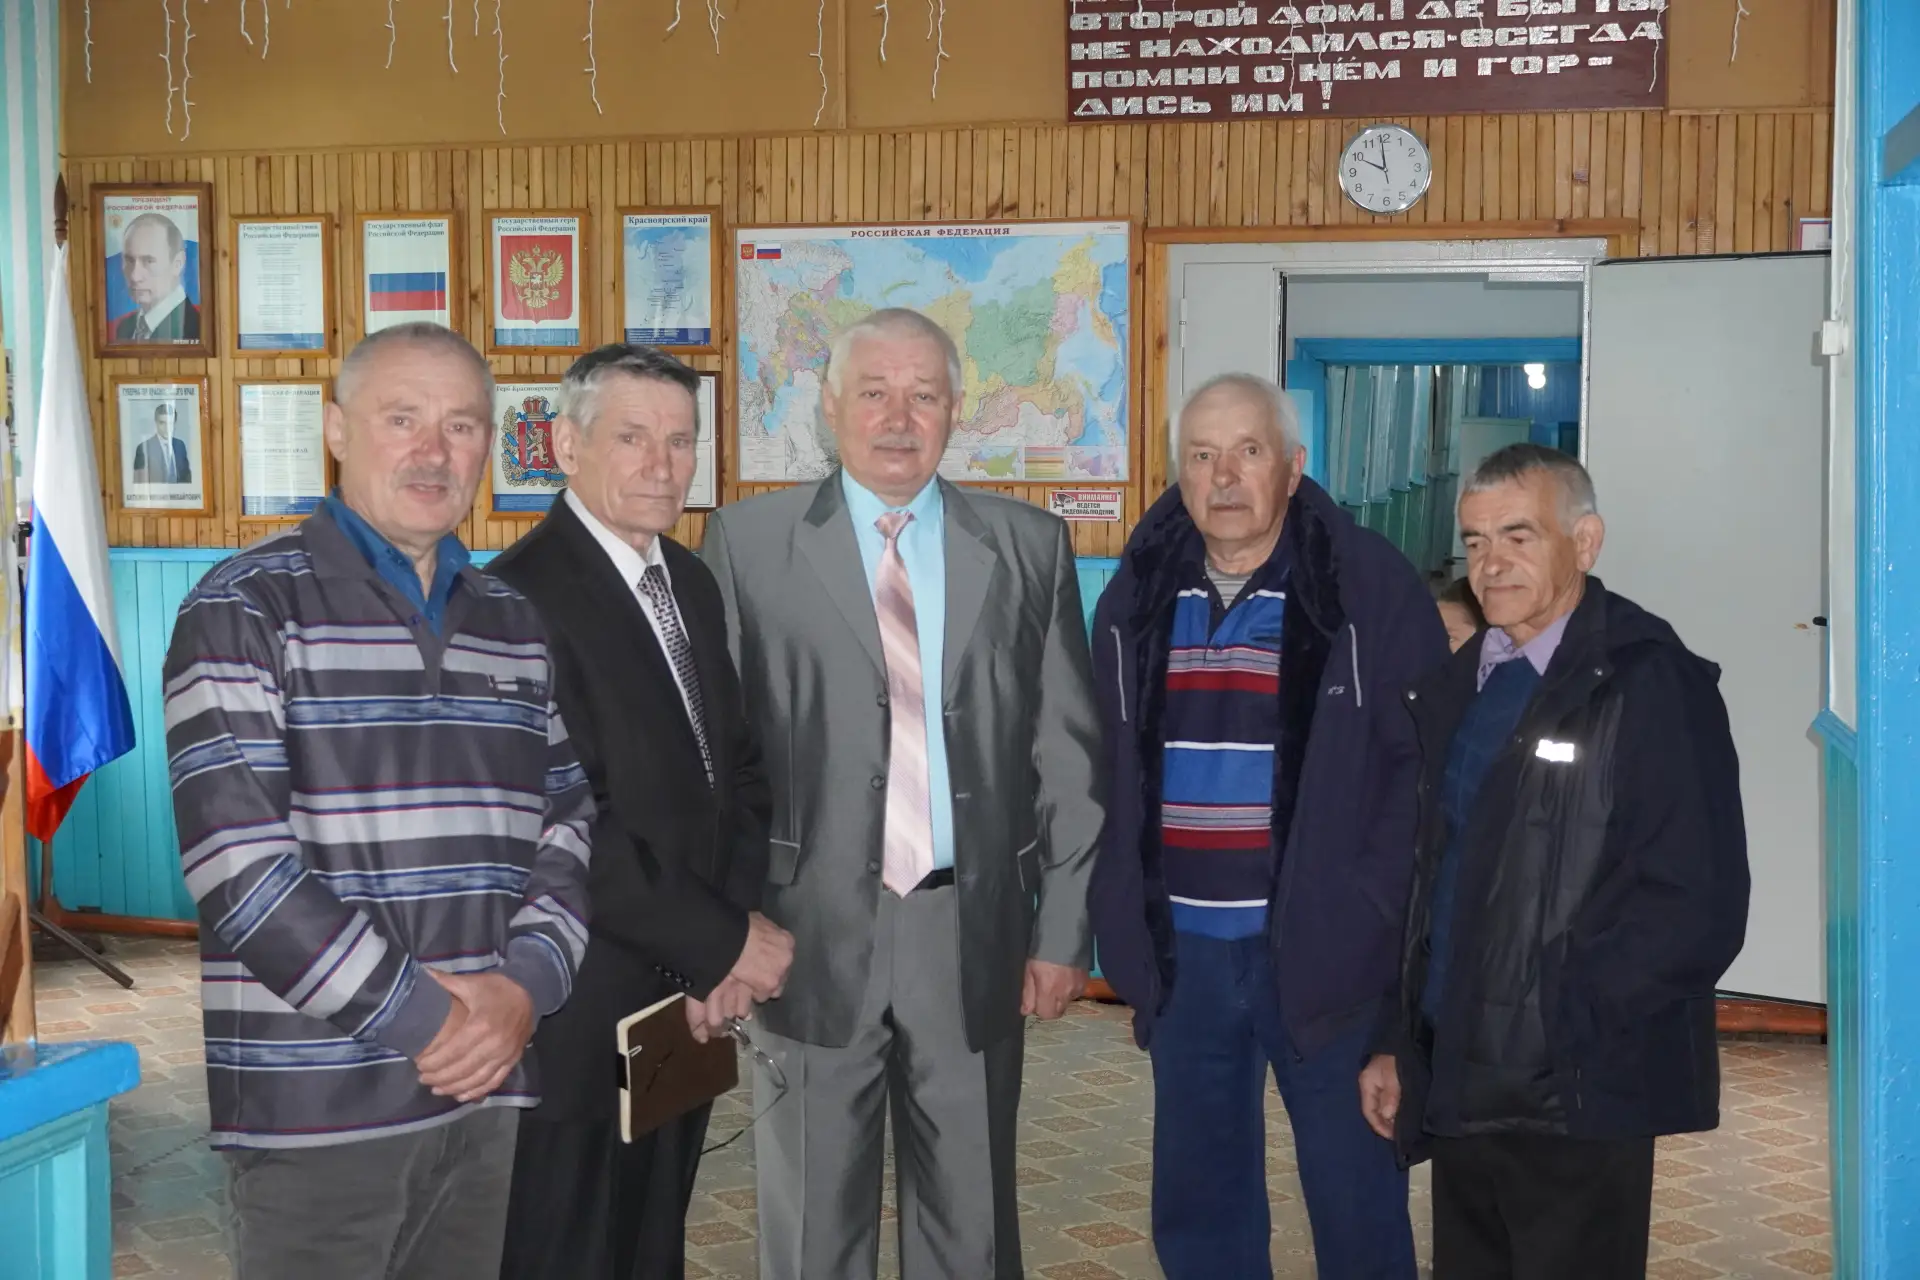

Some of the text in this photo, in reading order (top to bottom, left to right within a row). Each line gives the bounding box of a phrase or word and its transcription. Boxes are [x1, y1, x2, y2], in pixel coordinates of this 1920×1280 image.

[1069, 1, 1258, 31] ВТОРОЙ
[1267, 3, 1385, 25] ДОМ.
[1070, 41, 1131, 60] НЕ
[1072, 66, 1241, 89] ПОМНИ
[1253, 65, 1285, 83] О
[1423, 58, 1457, 78] И
[1073, 95, 1212, 116] ДИСЬ
[1363, 138, 1374, 148] 11
[1377, 133, 1391, 143] 12
[1352, 151, 1364, 161] 10
[367, 220, 445, 231] Государственный флаг
[628, 215, 708, 226] Красноярский край
[367, 230, 445, 238] Российской Федерации
[497, 225, 576, 233] Российской Федерации
[850, 226, 1011, 238] РОССИЙСКАЯ ФЕДЕРАЦИЯ
[496, 385, 511, 393] Герб
